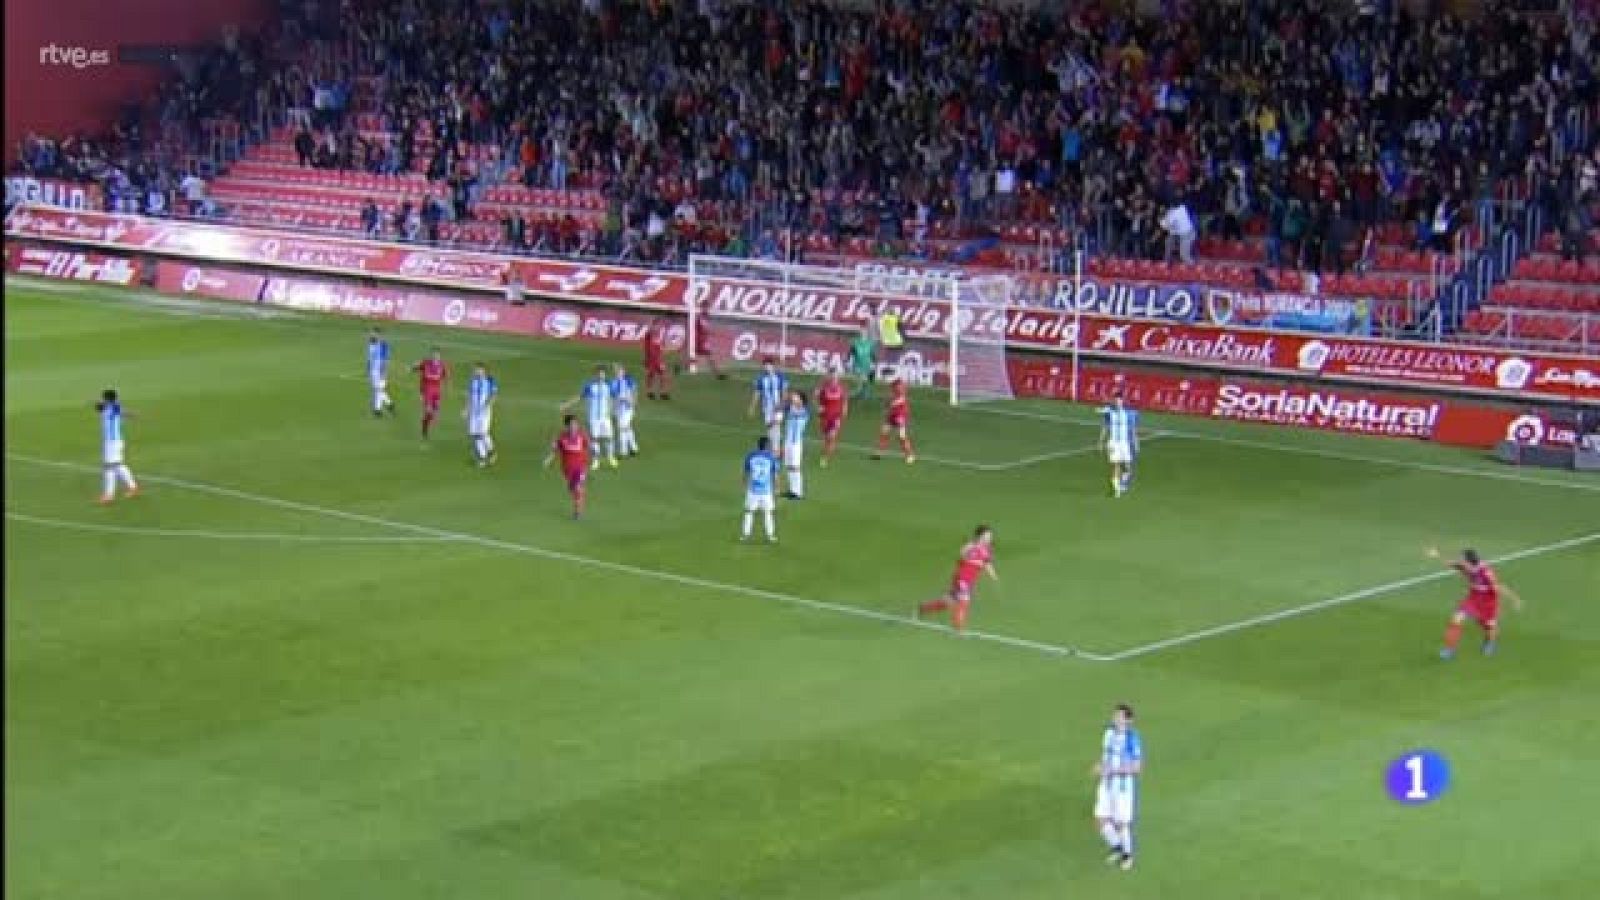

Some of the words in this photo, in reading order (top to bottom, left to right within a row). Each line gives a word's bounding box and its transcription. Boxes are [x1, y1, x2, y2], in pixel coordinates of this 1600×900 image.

[714, 284, 838, 321] NORMA
[1054, 278, 1193, 318] ROJILLO
[1140, 326, 1275, 367] CaixaBank
[1217, 384, 1440, 427] SoriaNatural
